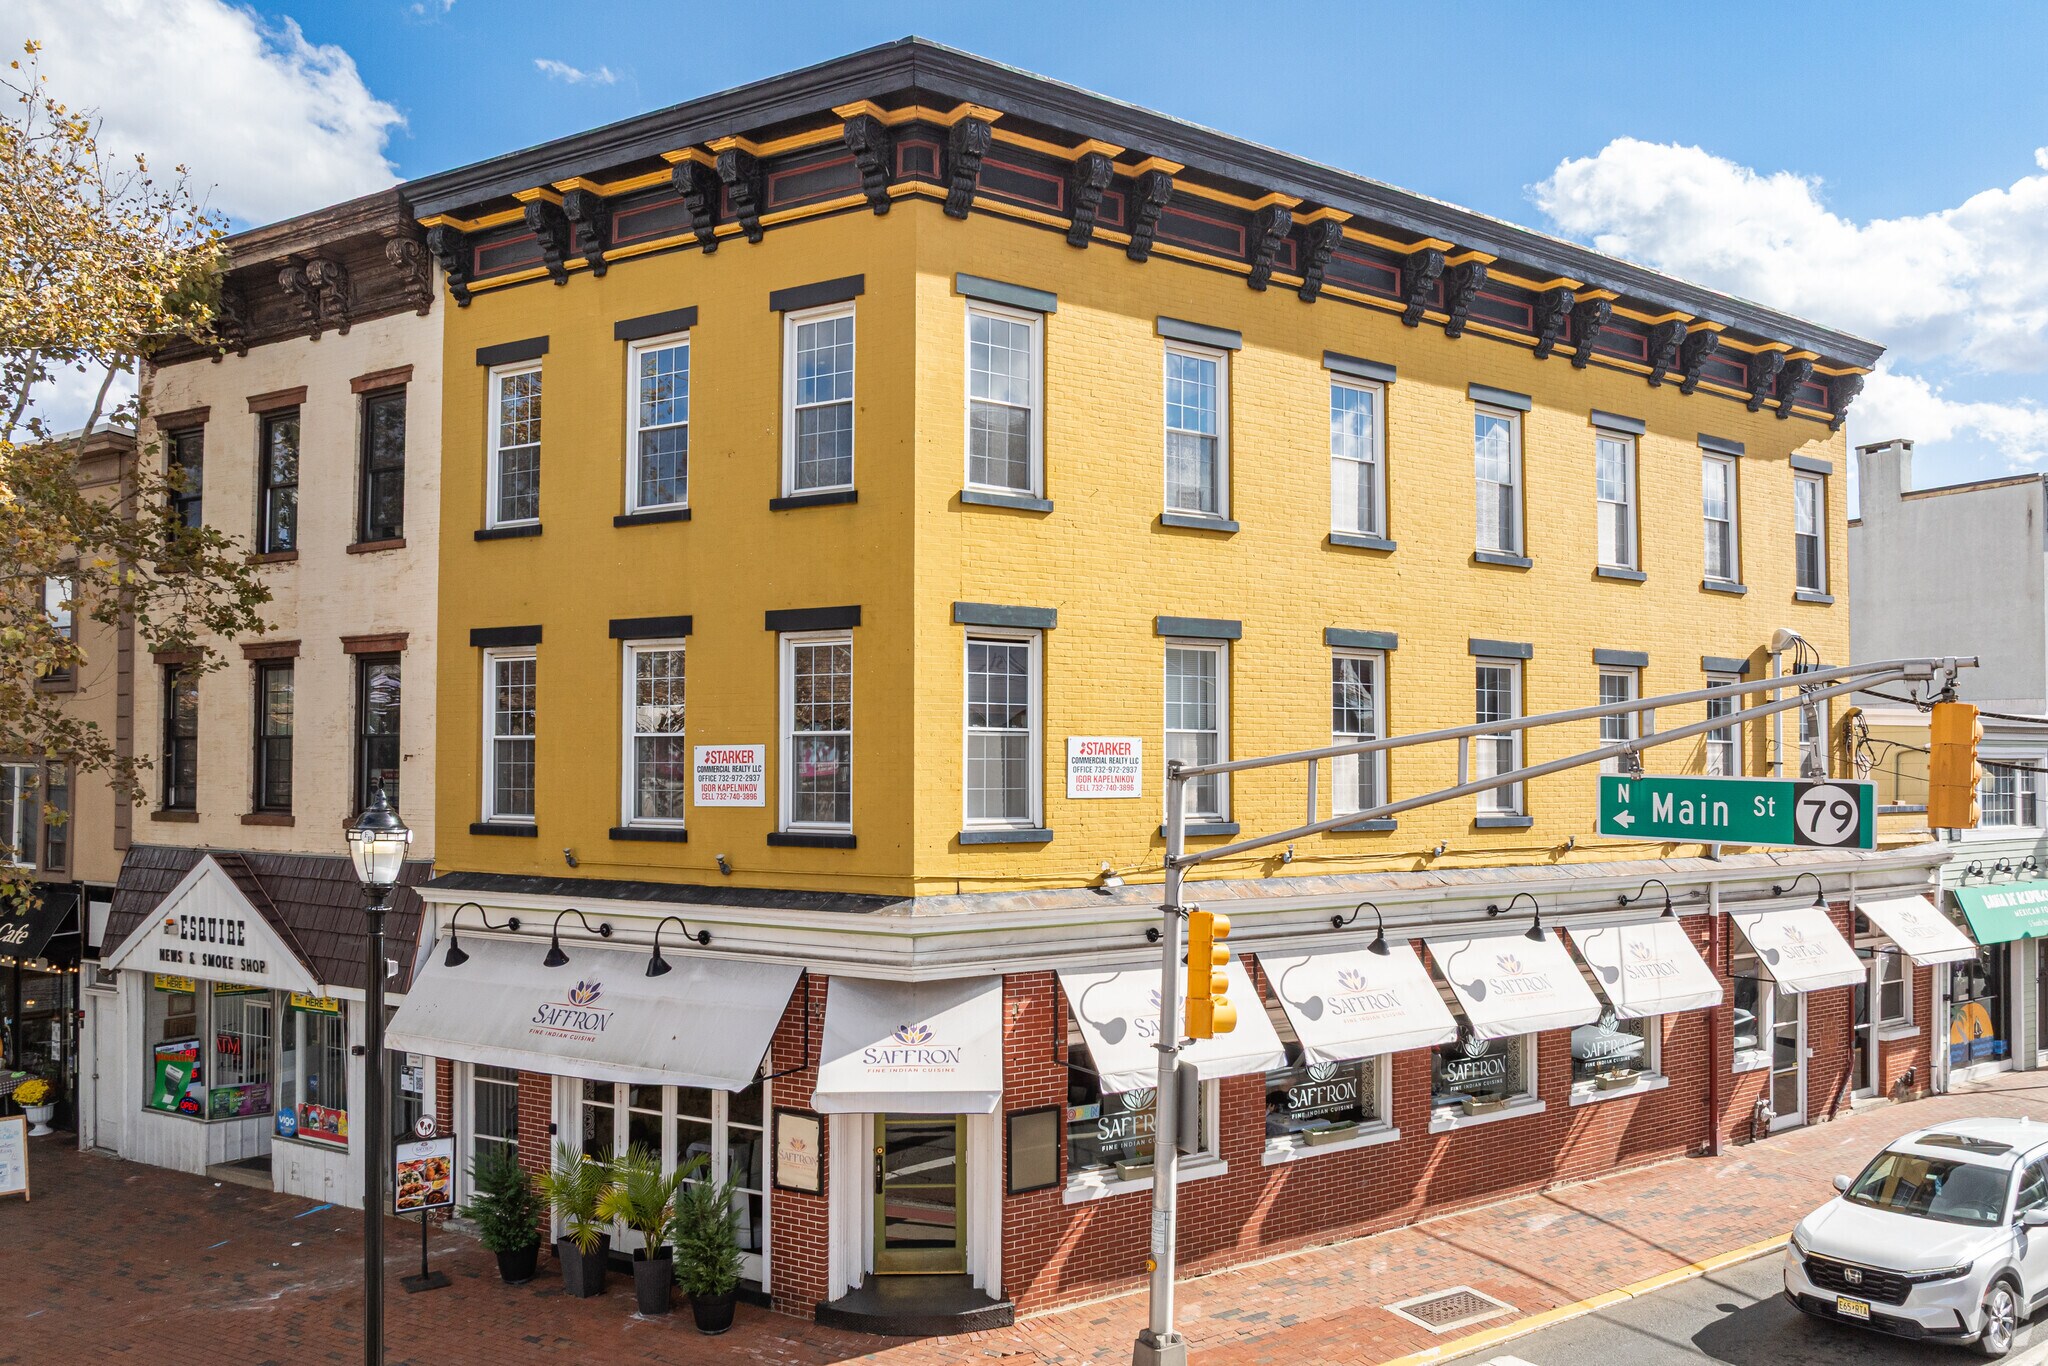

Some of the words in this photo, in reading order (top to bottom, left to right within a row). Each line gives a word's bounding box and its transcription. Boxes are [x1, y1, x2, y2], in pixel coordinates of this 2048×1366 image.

[1086, 742, 1131, 755] STARKER
[711, 750, 754, 764] STARKER
[697, 765, 730, 773] COMMERCIAL
[732, 765, 751, 773] REALTY
[752, 765, 762, 773] LLC
[718, 774, 760, 782] 732-972-2937
[1076, 775, 1092, 783] IGOR
[1093, 775, 1134, 783] KAPELNIKOV
[701, 784, 716, 792] IGOR
[718, 783, 757, 792] KAPELNIKOV
[1617, 783, 1629, 803] N
[1652, 792, 1729, 827] Main
[1753, 795, 1776, 817] St
[1803, 799, 1851, 834] 79
[0, 923, 29, 944] Cafe
[180, 915, 245, 947] ESQUIRE
[159, 948, 183, 963] NEWS
[189, 952, 196, 965] &
[202, 953, 234, 970] SMOKE
[240, 958, 266, 974] SHOP
[166, 980, 182, 989] HERE
[1488, 973, 1553, 995] SAFFRON
[306, 996, 323, 1007] HERE
[1327, 989, 1402, 1015] SAFFRON
[532, 1003, 614, 1032] SAFFRON
[569, 1034, 596, 1042] CUISINE
[863, 1047, 961, 1064] SAFFRON
[1446, 1054, 1506, 1082] SAFFRON
[1288, 1078, 1358, 1109] SAFFRON
[1463, 1082, 1482, 1090] INDIAN
[180, 1101, 198, 1111] OPEN
[1291, 1112, 1306, 1120] FINE
[1307, 1109, 1329, 1117] INDIAN
[1330, 1104, 1354, 1113] CUISINE
[278, 1115, 295, 1126] vigo
[1097, 1113, 1157, 1140] SAFFR
[1101, 1144, 1118, 1152] FINE
[1120, 1140, 1146, 1149] INDIAN
[778, 1150, 817, 1166] SAFFRON
